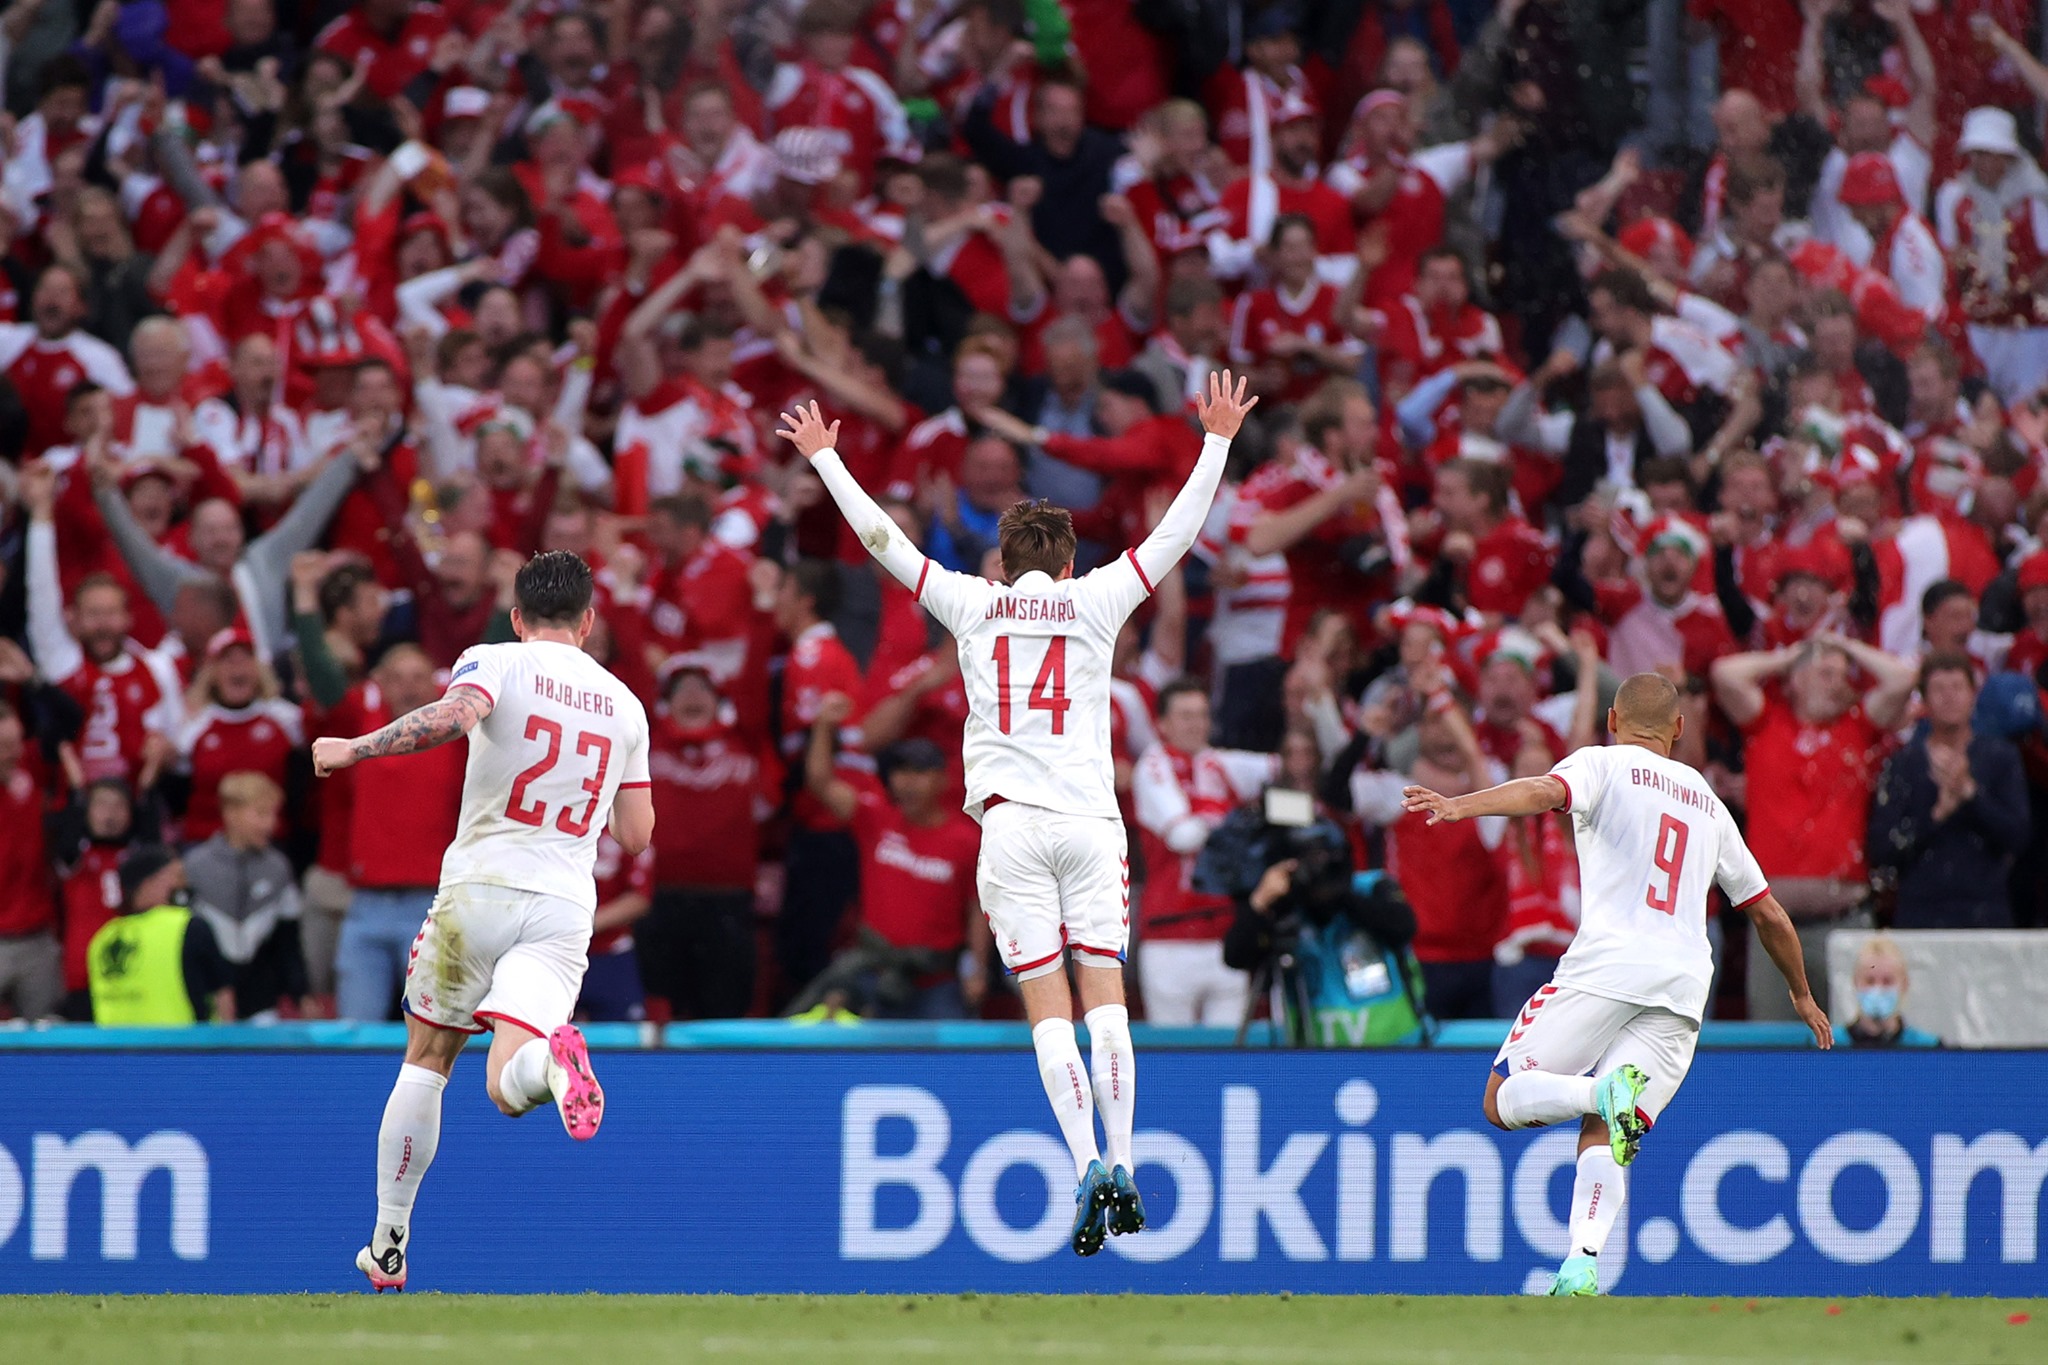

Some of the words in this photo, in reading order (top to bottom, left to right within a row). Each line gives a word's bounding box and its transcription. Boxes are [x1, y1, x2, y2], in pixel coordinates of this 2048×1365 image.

[535, 674, 615, 718] HØJBJERG
[991, 635, 1072, 736] 14
[503, 714, 612, 839] 23
[1631, 768, 1717, 820] BRAITHWAITE
[1646, 812, 1690, 916] 9
[1317, 1007, 1371, 1048] TV
[1066, 1062, 1084, 1110] DANMARK
[1111, 1052, 1120, 1102] DANMARK
[838, 1078, 2048, 1296] Booking.com
